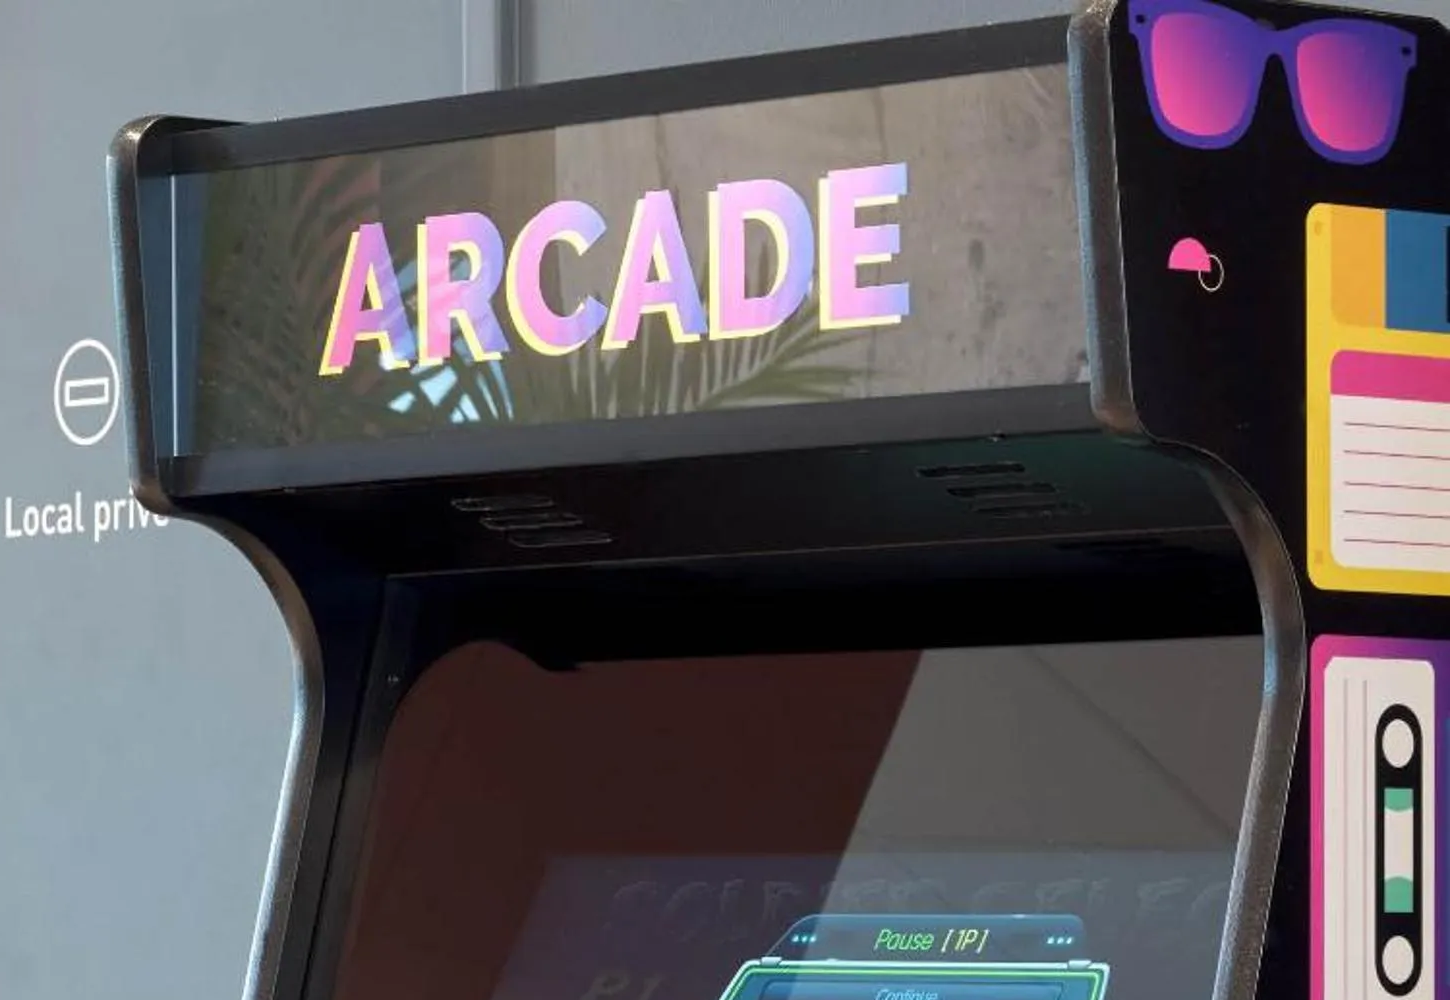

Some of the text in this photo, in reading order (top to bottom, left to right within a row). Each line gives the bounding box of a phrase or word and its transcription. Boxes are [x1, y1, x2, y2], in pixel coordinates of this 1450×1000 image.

[319, 163, 909, 376] ARCADE
[5, 490, 85, 538] Local
[874, 929, 934, 951] Pause
